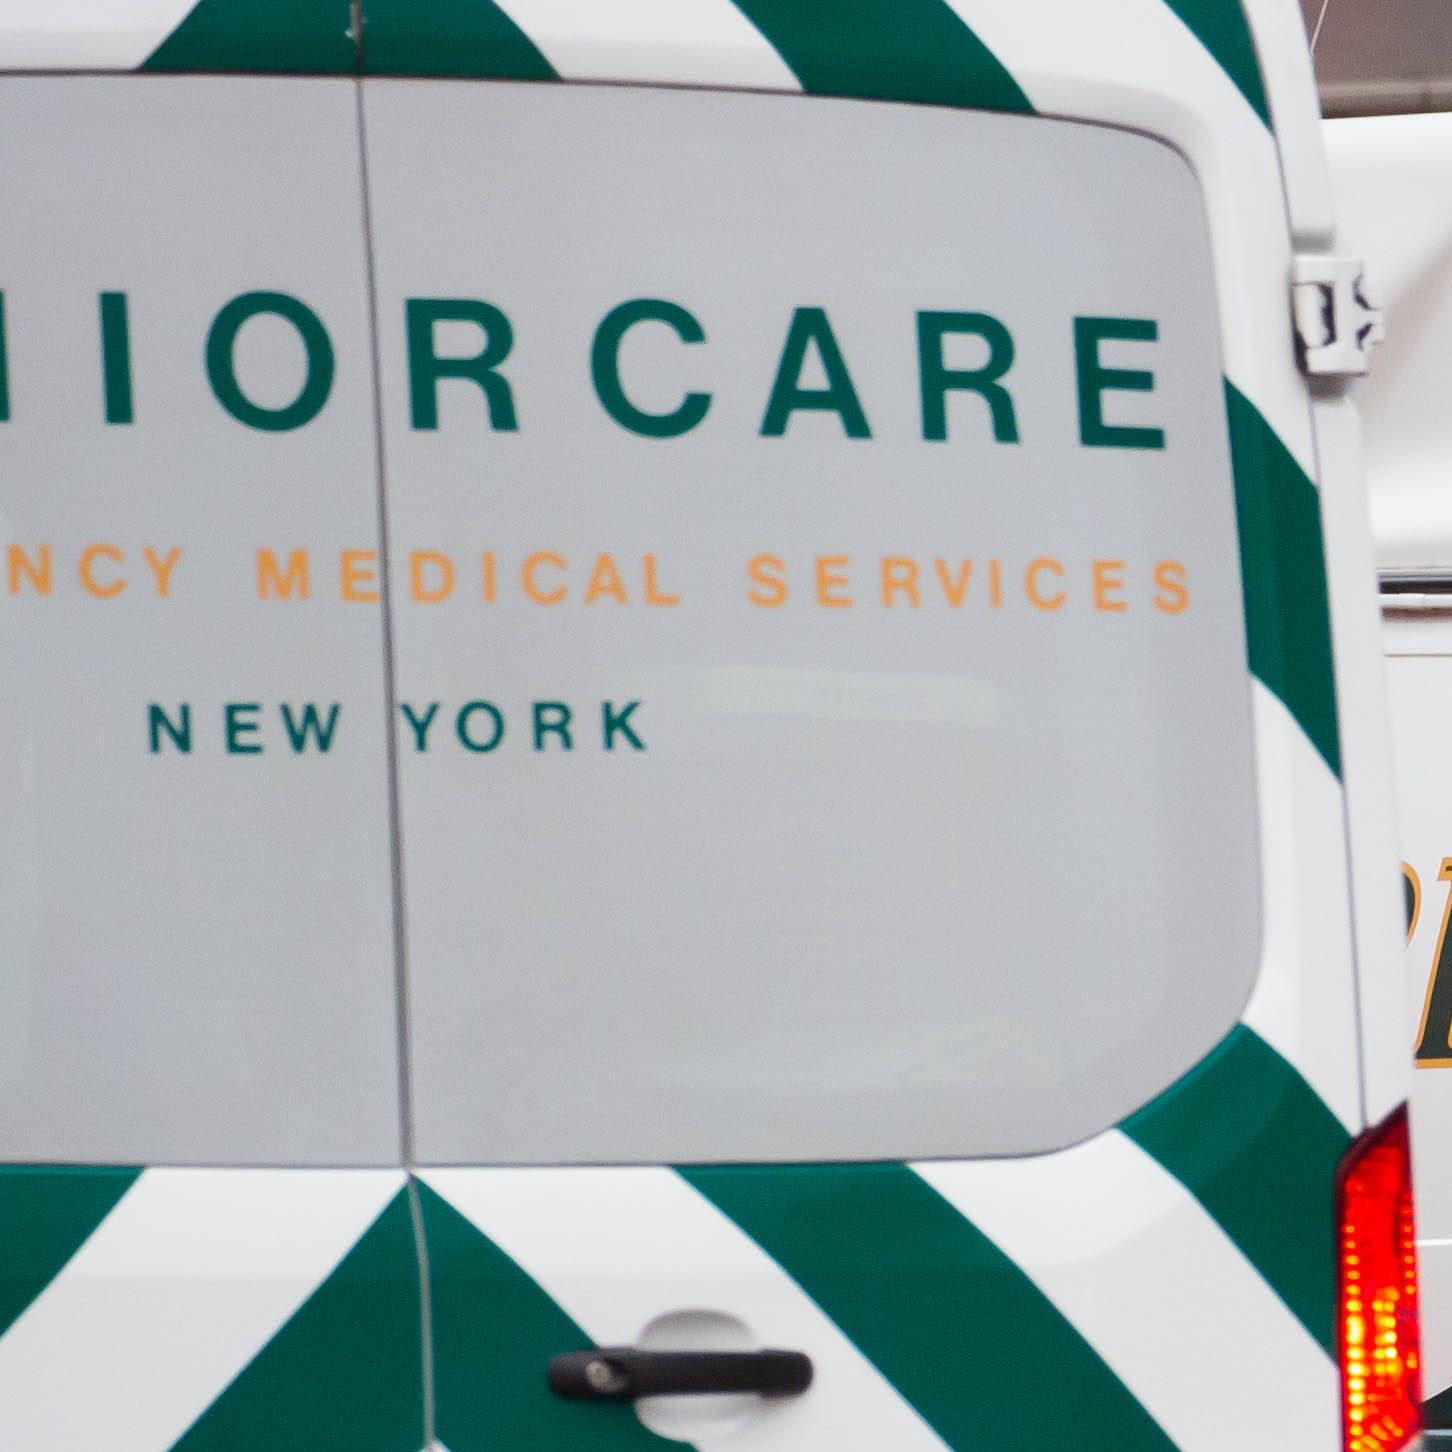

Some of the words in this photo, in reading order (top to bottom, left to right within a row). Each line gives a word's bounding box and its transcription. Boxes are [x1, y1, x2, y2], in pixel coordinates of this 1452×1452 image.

[0, 288, 1165, 450] IORCARE
[5, 542, 184, 599] NCY
[255, 546, 681, 607] MEDICAL
[746, 552, 1192, 614] SERVICES
[148, 703, 342, 754] NEW
[401, 701, 646, 753] YORK
